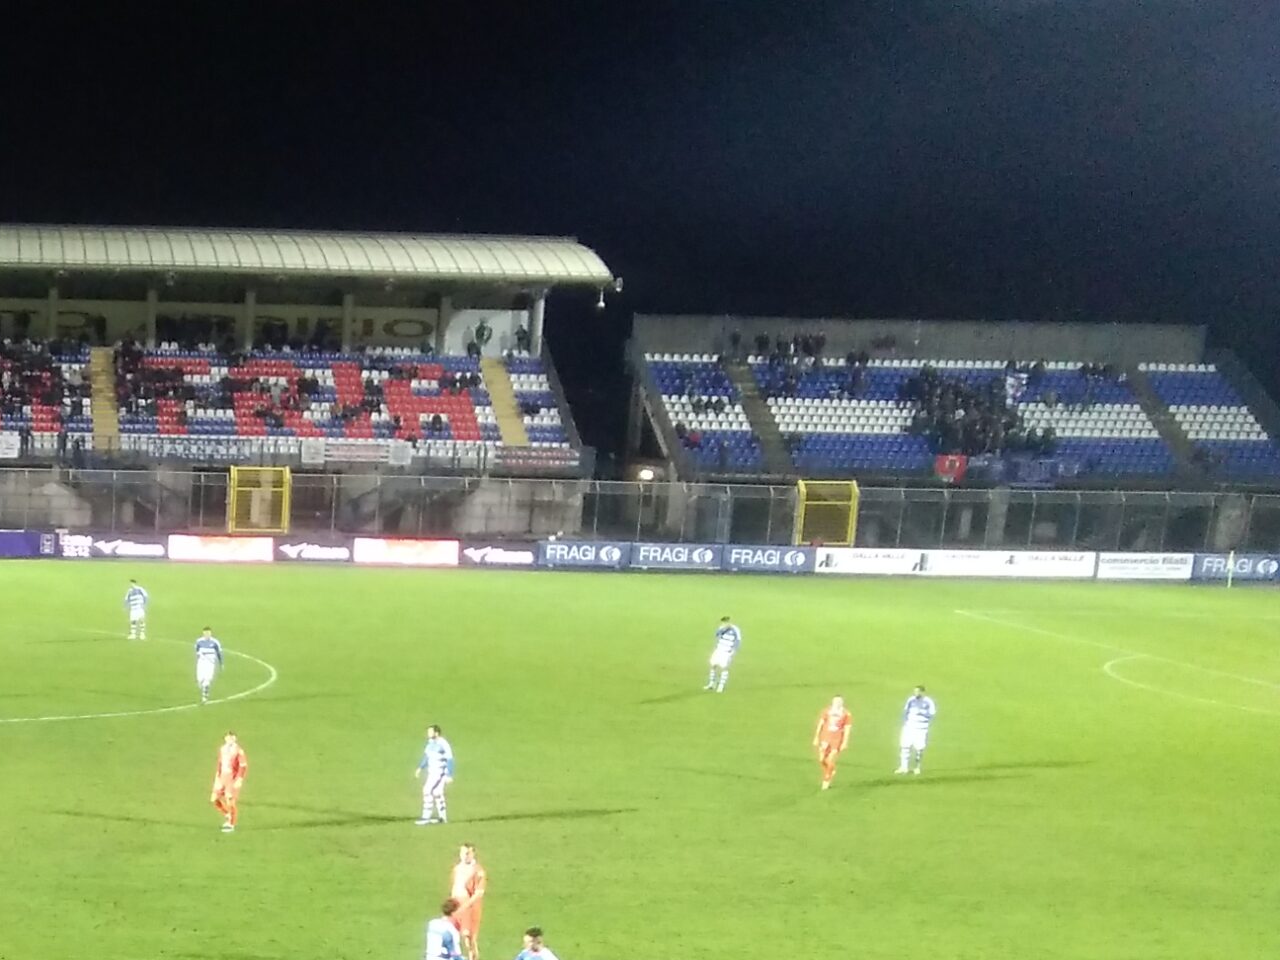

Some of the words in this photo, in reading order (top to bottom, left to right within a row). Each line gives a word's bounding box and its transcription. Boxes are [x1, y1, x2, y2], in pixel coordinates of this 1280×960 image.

[546, 545, 595, 561] FRAGI
[639, 546, 688, 562] FRAGI
[731, 549, 780, 565] FRAGI
[1202, 558, 1253, 573] FRAGI
